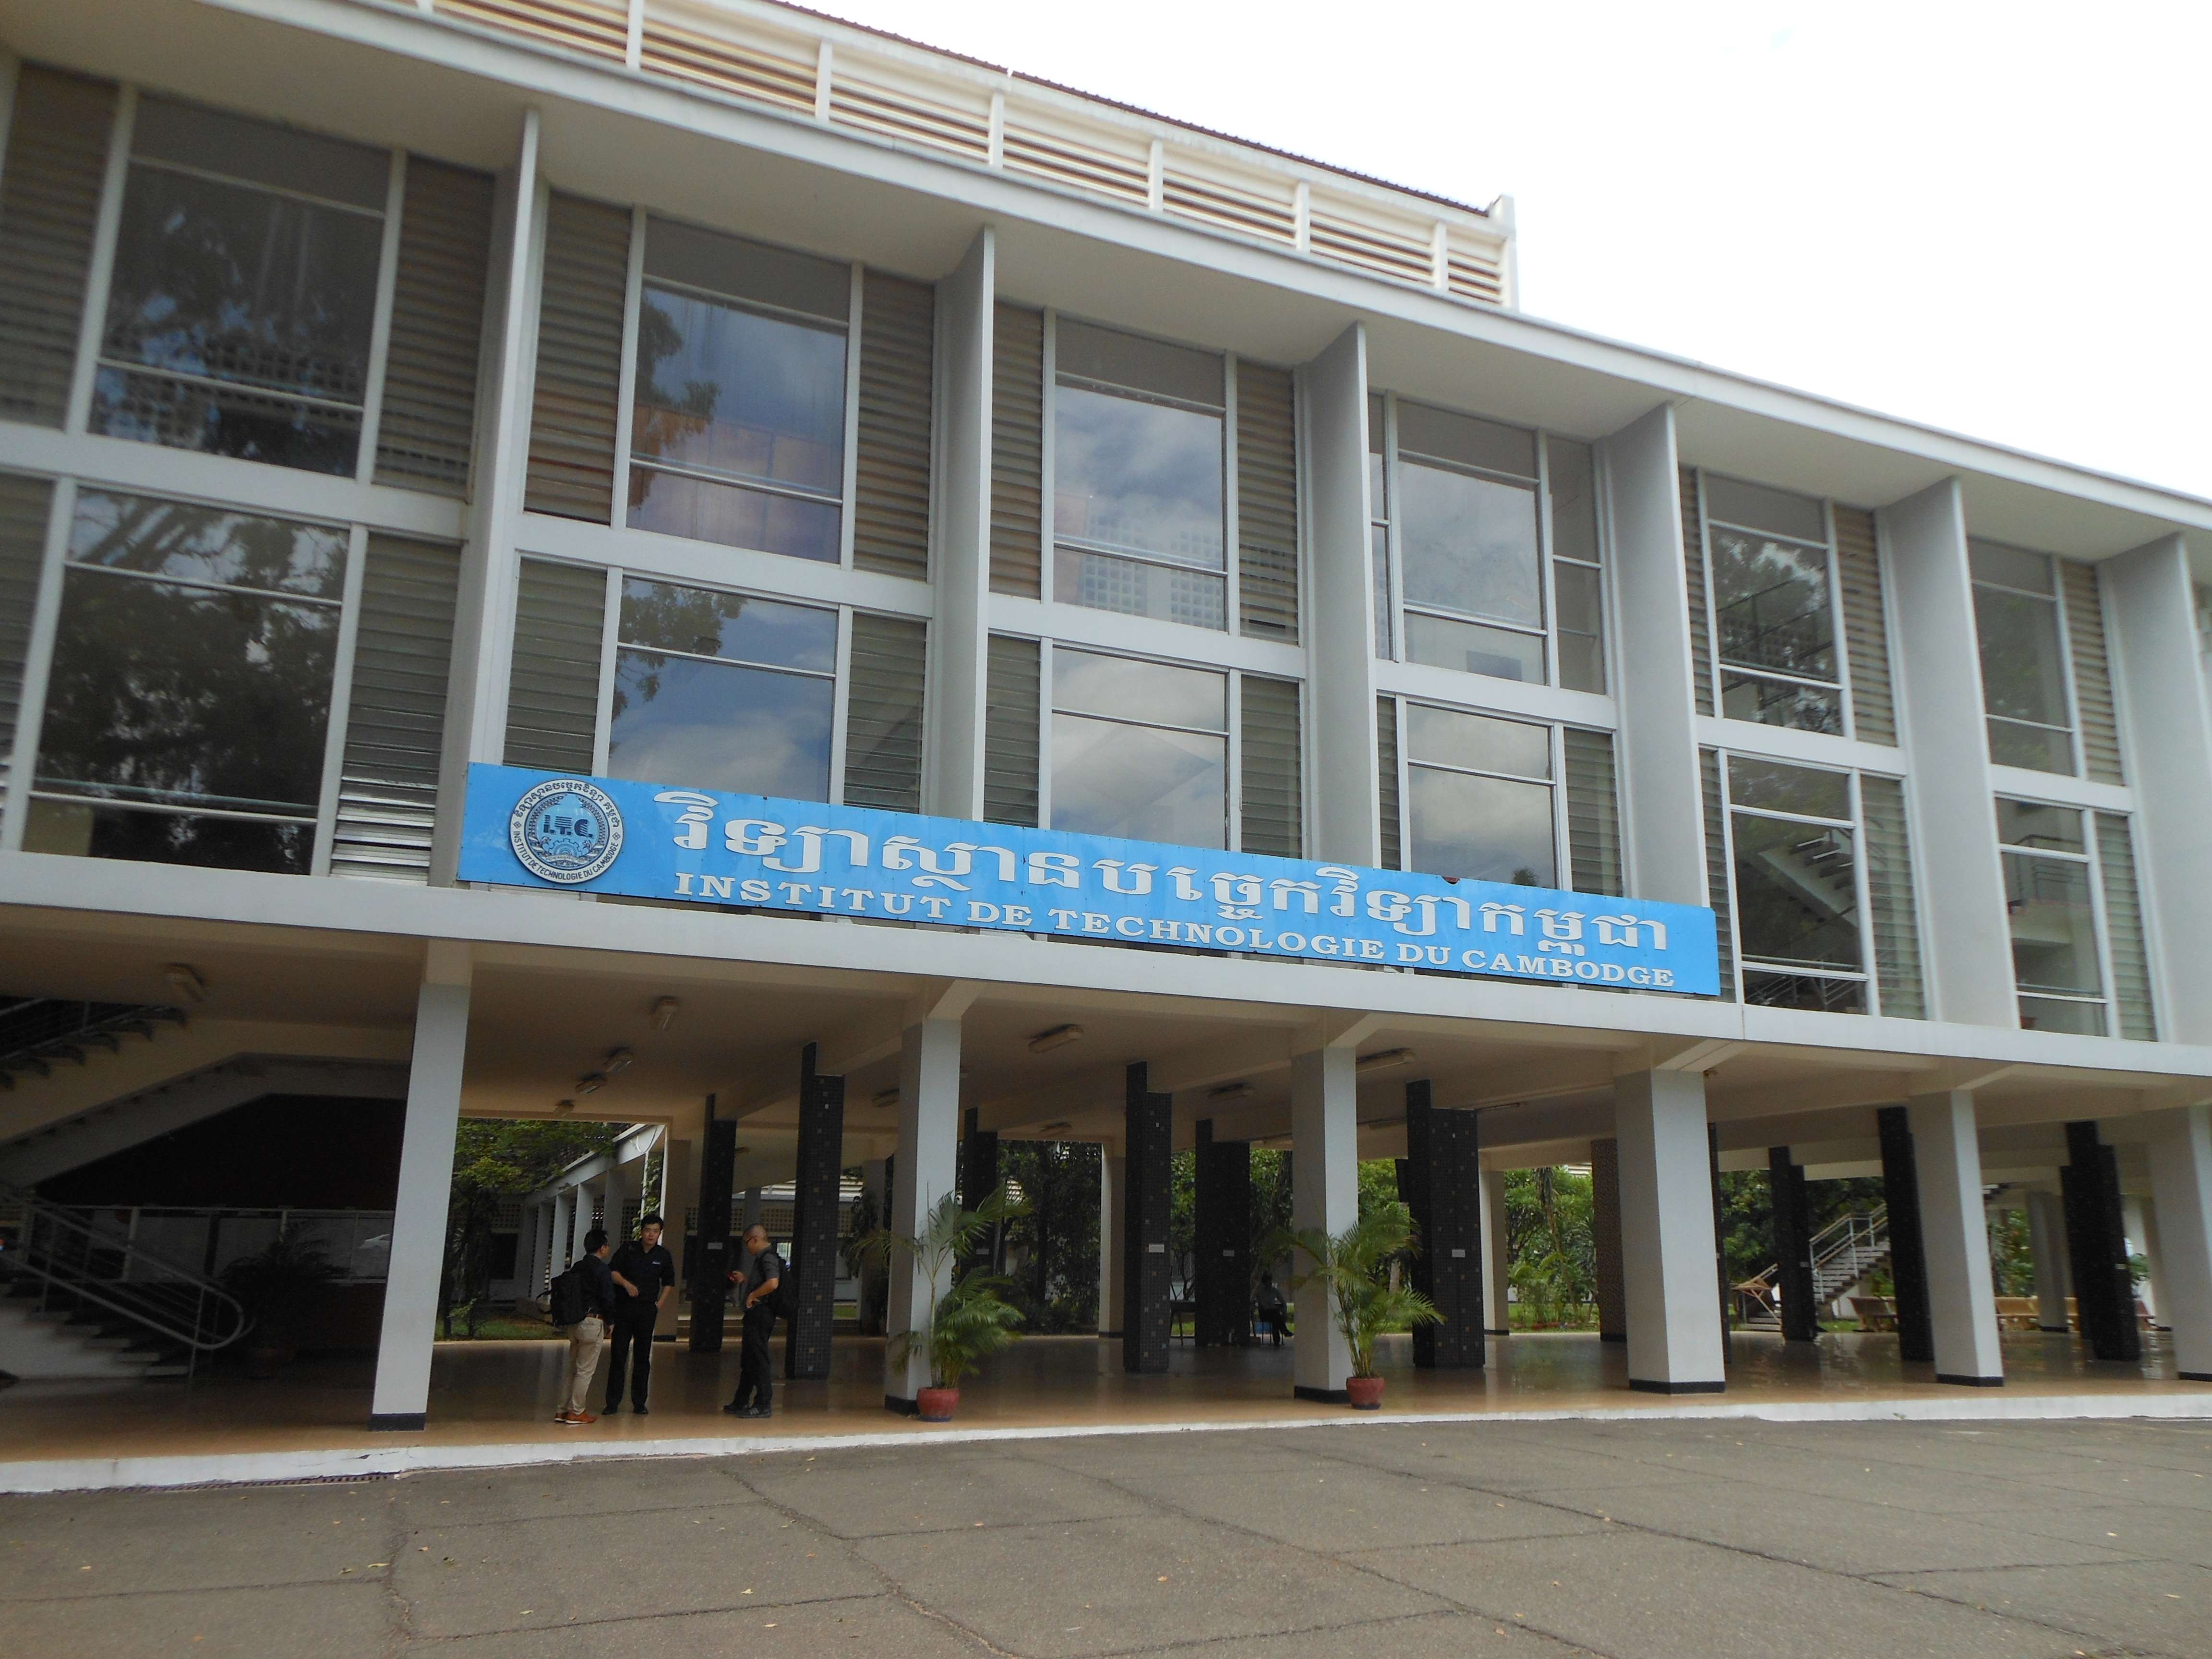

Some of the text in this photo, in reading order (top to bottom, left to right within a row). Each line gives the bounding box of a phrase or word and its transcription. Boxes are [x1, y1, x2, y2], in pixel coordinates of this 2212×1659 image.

[513, 831, 532, 861] INSTITUT
[528, 860, 539, 869] DE
[537, 865, 583, 880] TECHNOLOGIE
[583, 868, 593, 878] DU
[592, 842, 619, 873] CAMBODGE
[675, 872, 1674, 987] INSTITUT DE TECHNOLOGIE DU CAMBODGE
